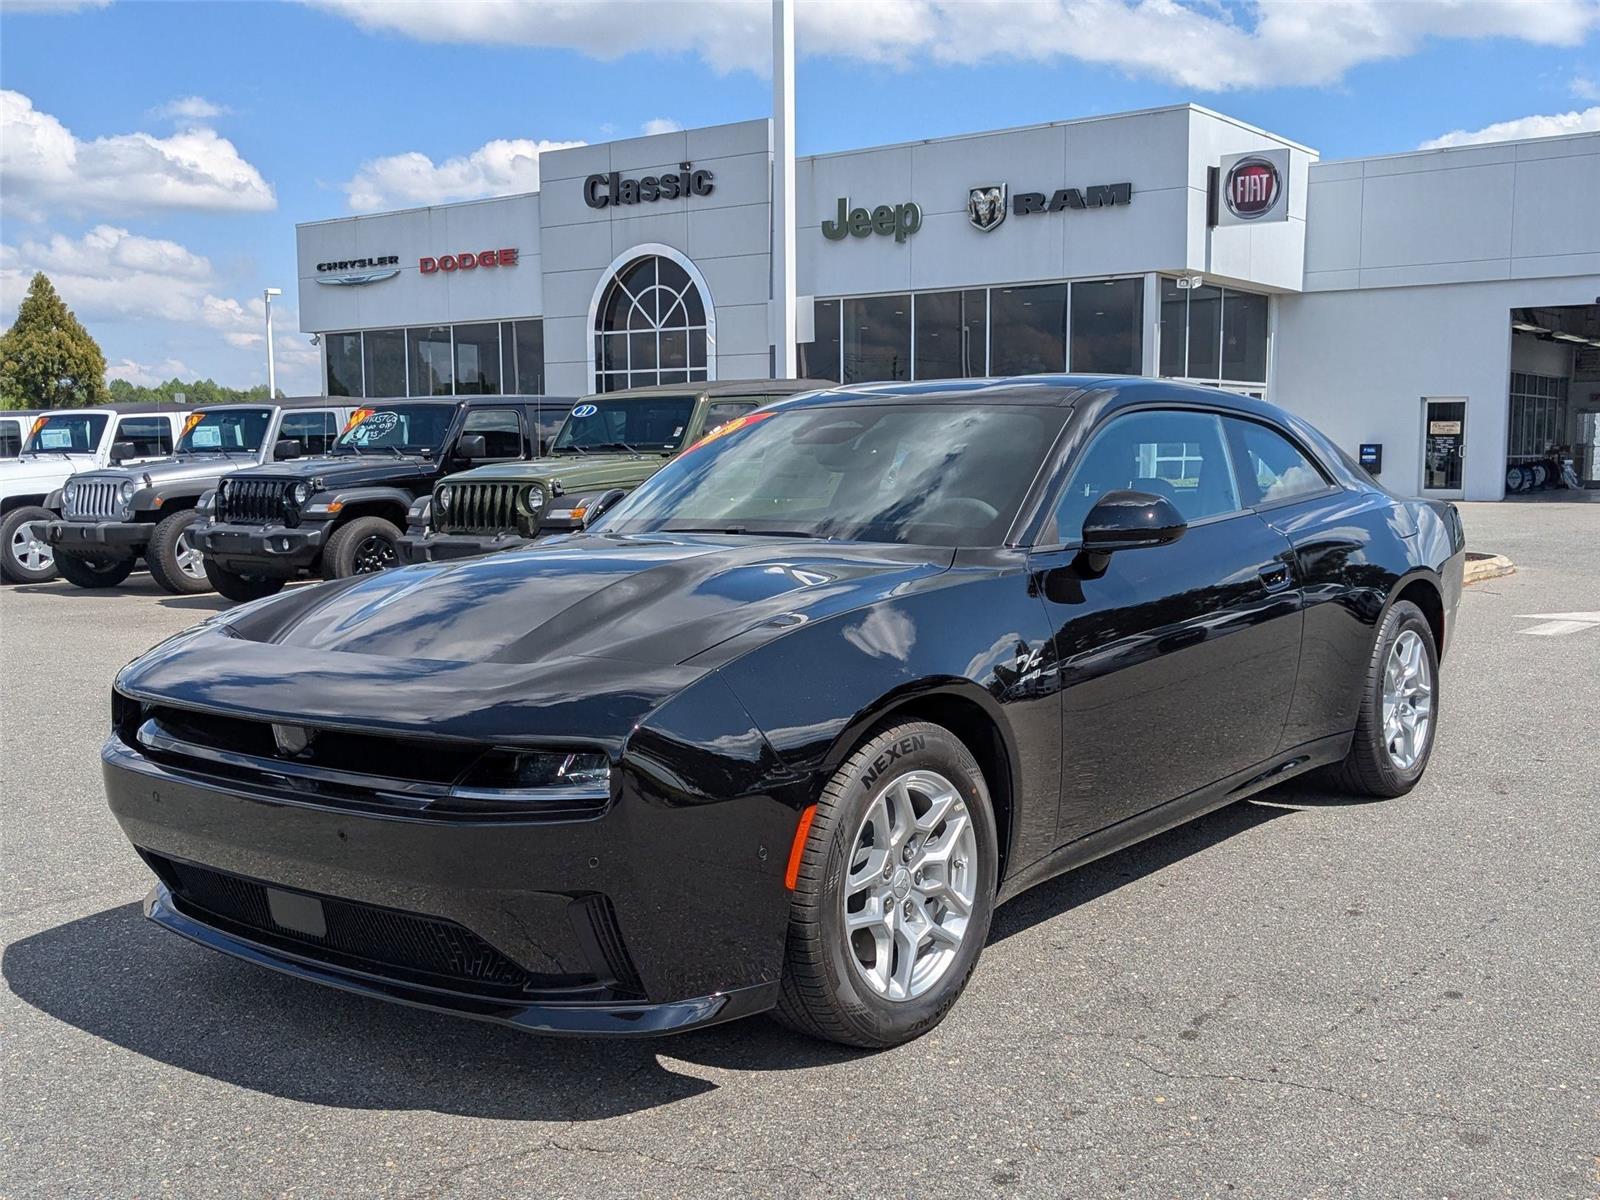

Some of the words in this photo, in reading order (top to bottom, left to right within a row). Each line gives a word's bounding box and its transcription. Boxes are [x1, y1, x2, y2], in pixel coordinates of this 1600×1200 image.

[583, 162, 714, 209] Classic
[1013, 182, 1131, 216] RAM
[1237, 174, 1269, 203] FIAT
[821, 198, 923, 243] Jeep
[316, 256, 399, 272] CHRYSLER
[419, 248, 519, 274] DODGE
[861, 735, 926, 791] NEXEN
